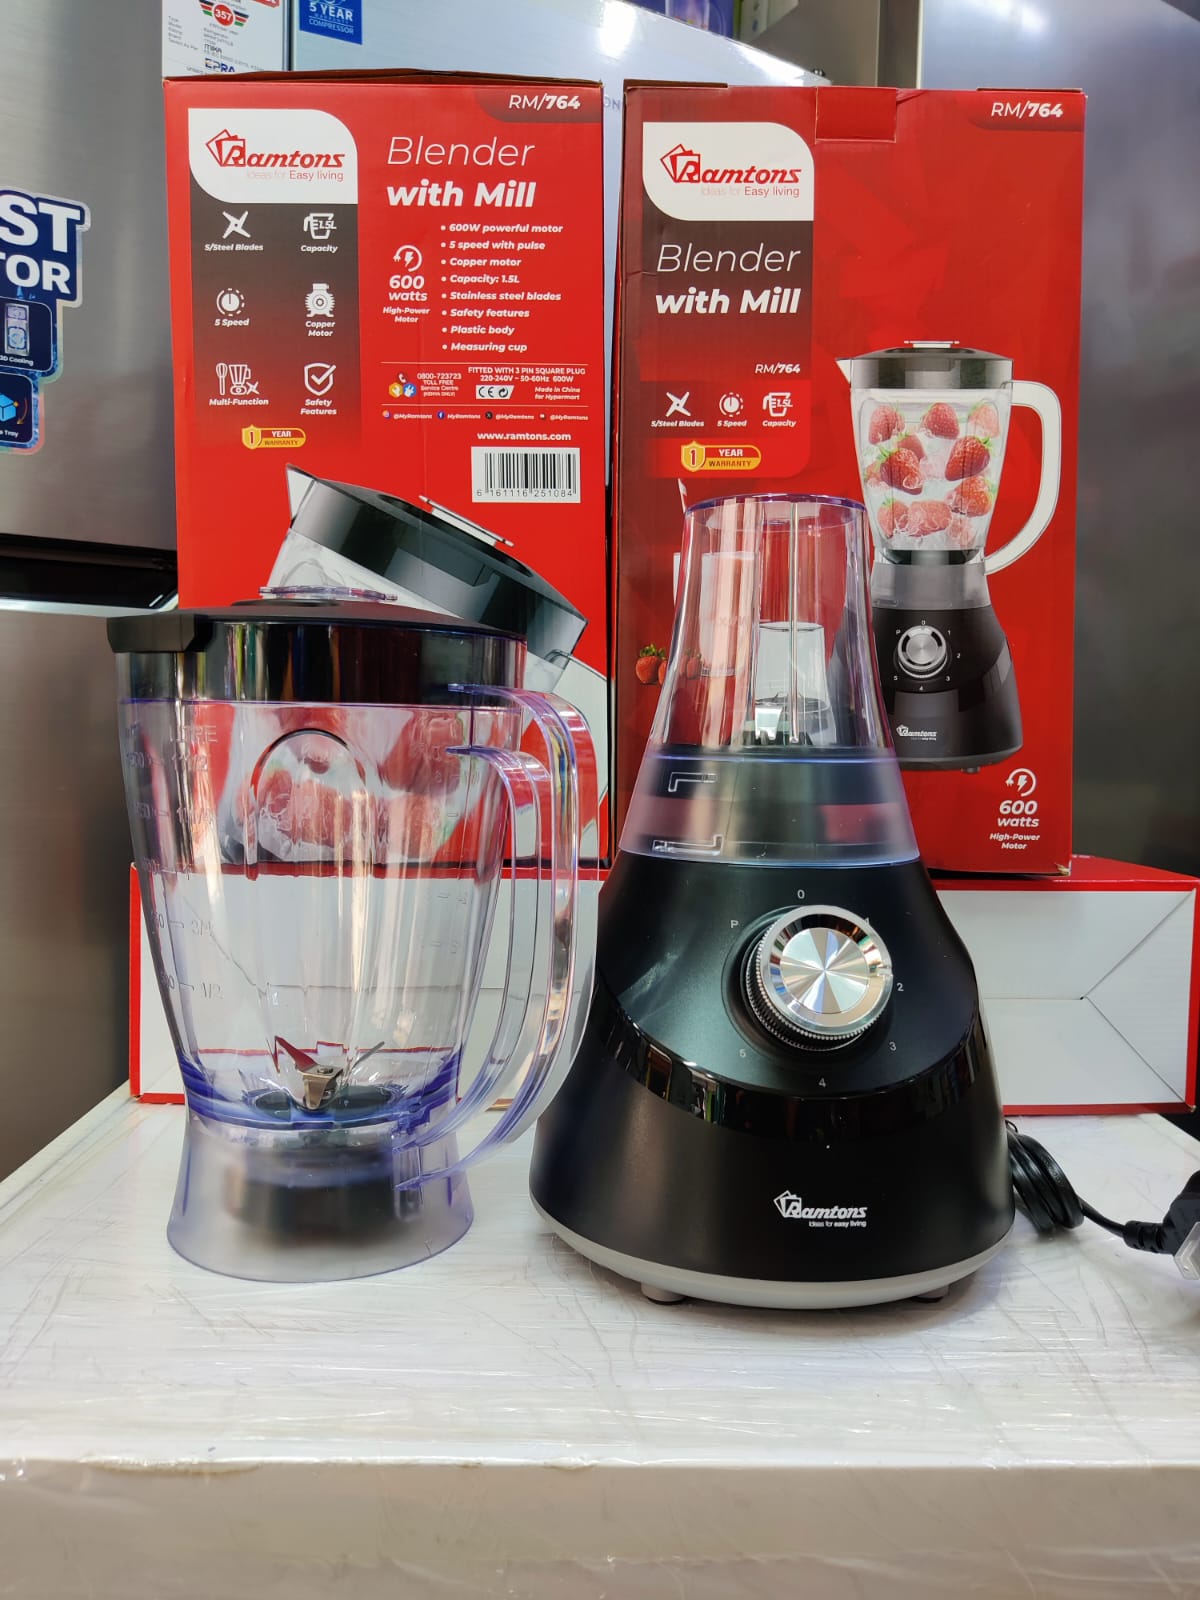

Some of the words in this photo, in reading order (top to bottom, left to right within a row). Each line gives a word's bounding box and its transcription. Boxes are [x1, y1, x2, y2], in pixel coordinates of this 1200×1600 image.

[215, 8, 232, 21] 357
[309, 2, 317, 12] 5
[320, 4, 353, 21] YEAR
[309, 18, 354, 35] COMPRESSOR
[508, 93, 581, 111] RM/764
[990, 100, 1064, 119] RM/764
[219, 138, 345, 168] Ramtons
[387, 136, 535, 166] Blender
[675, 154, 802, 184] Ramtons
[289, 169, 314, 182] Easy
[317, 169, 344, 183] living
[386, 178, 464, 207] with
[473, 179, 536, 208] Mill
[744, 186, 769, 198] Easy
[772, 186, 800, 198] living
[449, 224, 481, 233] 600W
[482, 224, 530, 235] powerful
[531, 225, 563, 233] motor
[204, 243, 234, 251] S/Steel
[235, 243, 264, 251] Blades
[300, 244, 338, 254] Capacity
[449, 241, 456, 250] 5
[457, 241, 490, 252] speed
[491, 241, 515, 250] with
[517, 241, 546, 251] pulse
[656, 242, 801, 272] Blender
[449, 258, 487, 269] Copper
[489, 258, 522, 267] motor
[388, 274, 425, 290] 600
[449, 274, 499, 285] Capacity:
[501, 275, 520, 284] 1.5L
[388, 291, 428, 302] watts
[449, 291, 498, 301] Stainless
[498, 292, 526, 301] steel
[526, 292, 562, 301] blades
[655, 287, 730, 314] with
[739, 287, 802, 314] Mill
[382, 306, 430, 316] High-Power
[450, 308, 484, 319] Safety
[485, 308, 531, 317] features
[214, 318, 221, 326] 5
[221, 318, 250, 328] Speed
[305, 320, 336, 329] Copper
[394, 315, 419, 323] Motor
[308, 329, 334, 337] Motor
[450, 325, 487, 335] Plastic
[488, 325, 515, 336] body
[450, 342, 506, 353] Measuring
[507, 344, 528, 353] cup
[9, 356, 34, 367] Cooling
[754, 363, 801, 375] RM/764
[209, 397, 269, 406] Multi-Function
[304, 398, 333, 407] Safety
[300, 407, 337, 415] Features
[650, 419, 678, 427] S/Steel
[723, 420, 747, 428] Speed
[762, 420, 797, 428] Capacity
[271, 430, 292, 438] YEAR
[476, 431, 572, 442] www.ramtons.com
[718, 449, 743, 457] YEAR
[708, 460, 752, 468] WARRANTY
[476, 489, 483, 497] 6
[533, 489, 573, 498] 251084
[999, 799, 1038, 815] 600
[997, 816, 1039, 828] watts
[989, 832, 1040, 841] High-Power
[1001, 842, 1027, 850] Motor
[797, 889, 805, 899] 0
[730, 920, 739, 929] P
[897, 982, 904, 992] 2
[889, 1041, 897, 1051] 3
[739, 1049, 746, 1058] 5
[818, 1078, 826, 1087] 4
[781, 1196, 868, 1219] Ramtons
